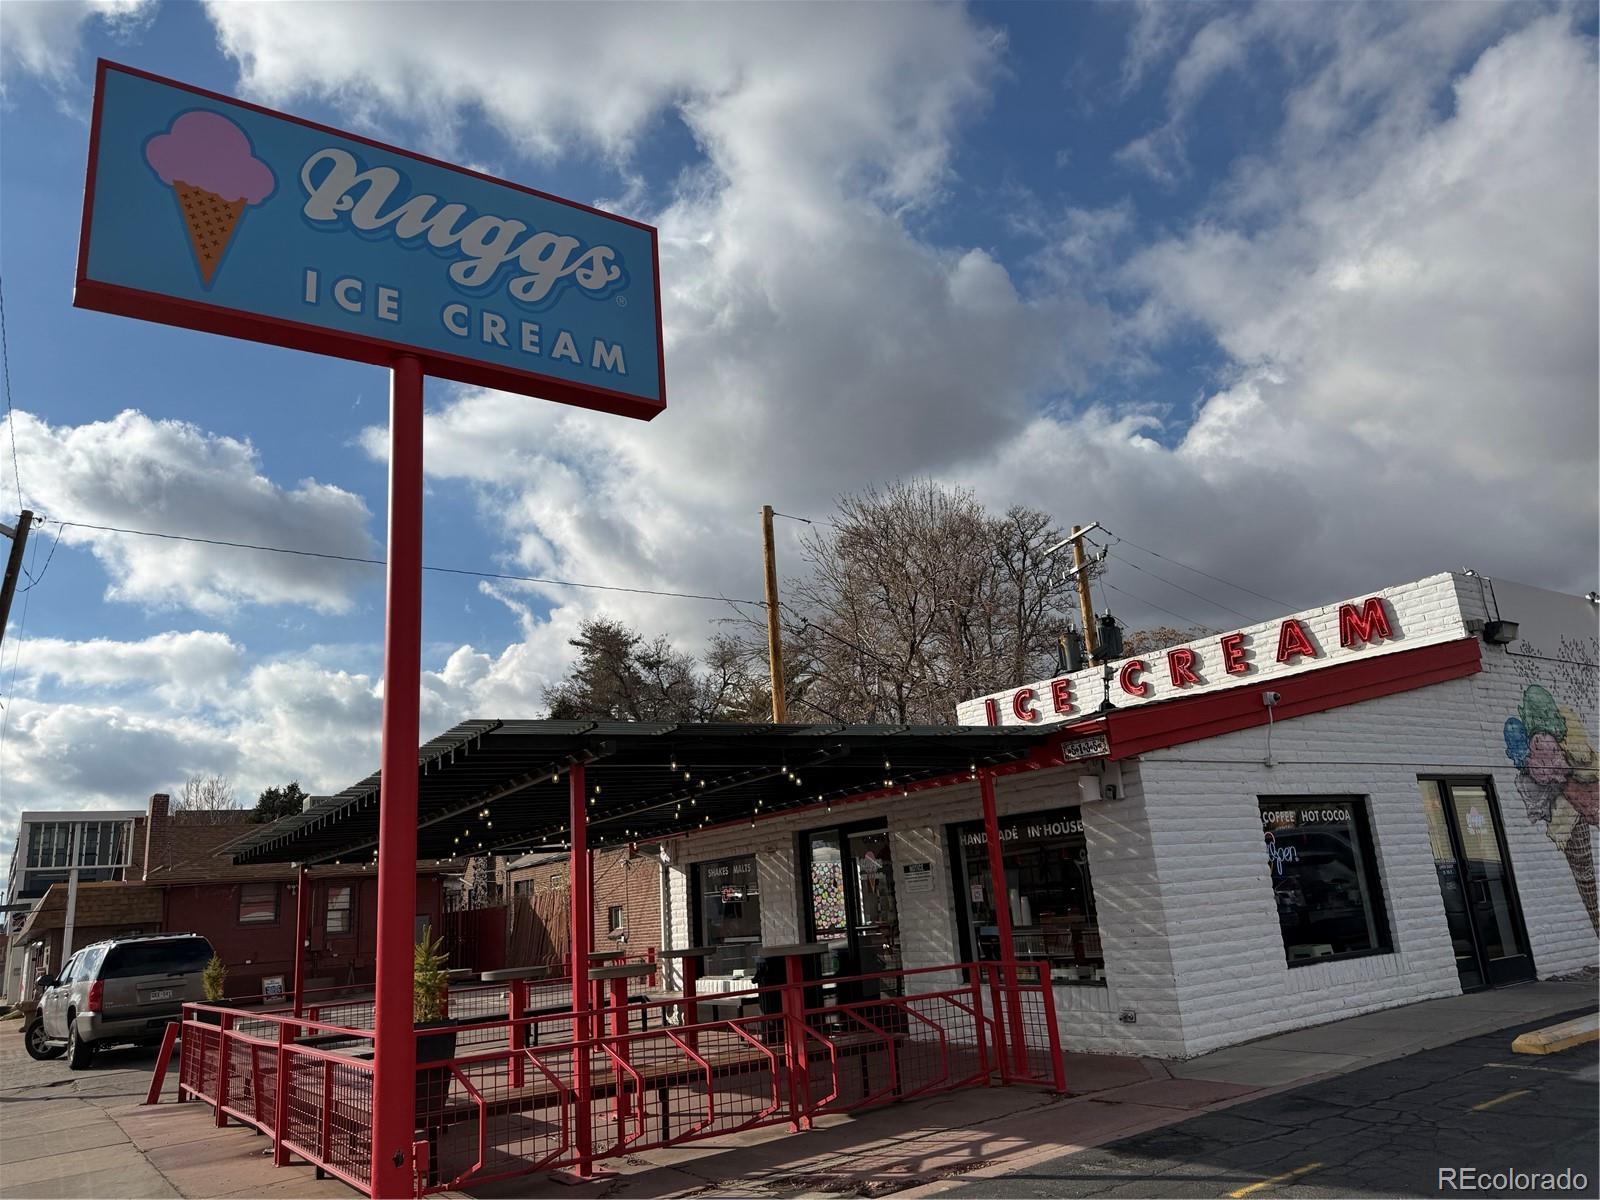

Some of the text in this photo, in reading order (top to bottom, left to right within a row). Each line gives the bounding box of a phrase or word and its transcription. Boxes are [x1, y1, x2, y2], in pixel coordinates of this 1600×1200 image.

[305, 270, 627, 375] ICE CREAM
[984, 596, 1393, 727] ICE CREAM
[1262, 809, 1352, 824] COFFEE HOT COCOA
[960, 820, 1084, 846] HANDADE IN HOUSE
[707, 863, 751, 878] SHAKES MALTS
